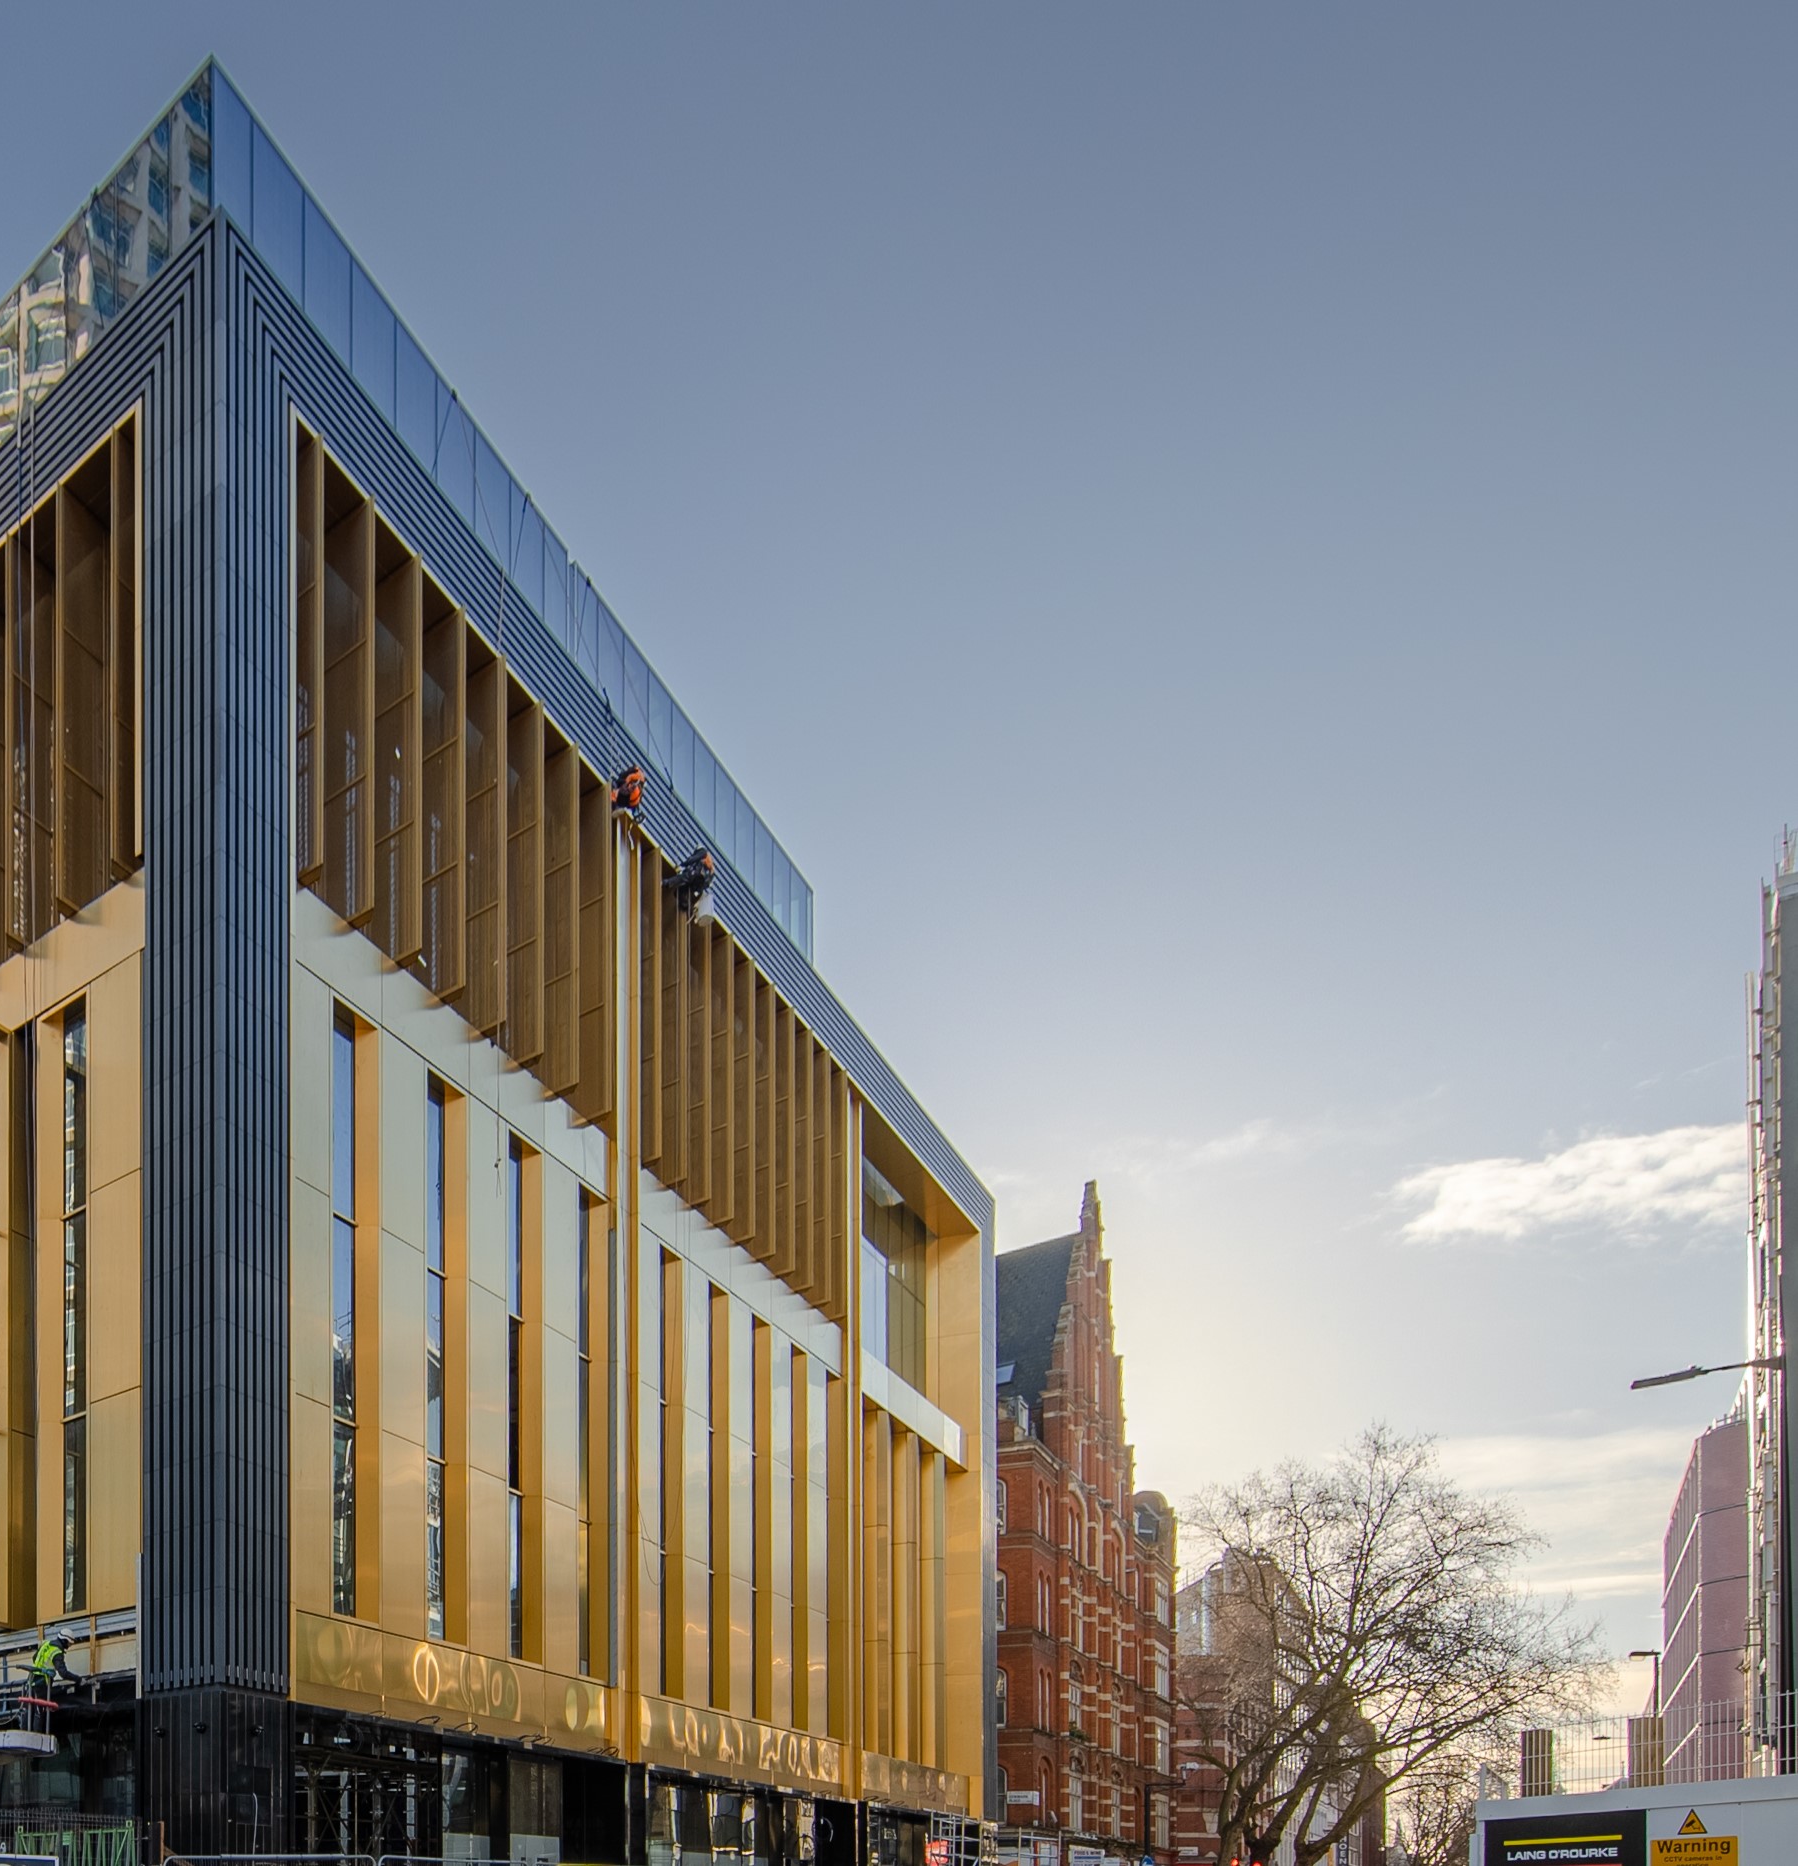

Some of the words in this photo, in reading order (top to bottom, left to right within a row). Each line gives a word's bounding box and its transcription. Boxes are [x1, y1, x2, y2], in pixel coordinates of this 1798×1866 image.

[1507, 1850, 1547, 1861] LAING
[1548, 1847, 1619, 1860] O'ROURKE
[1657, 1838, 1731, 1855] Warning
